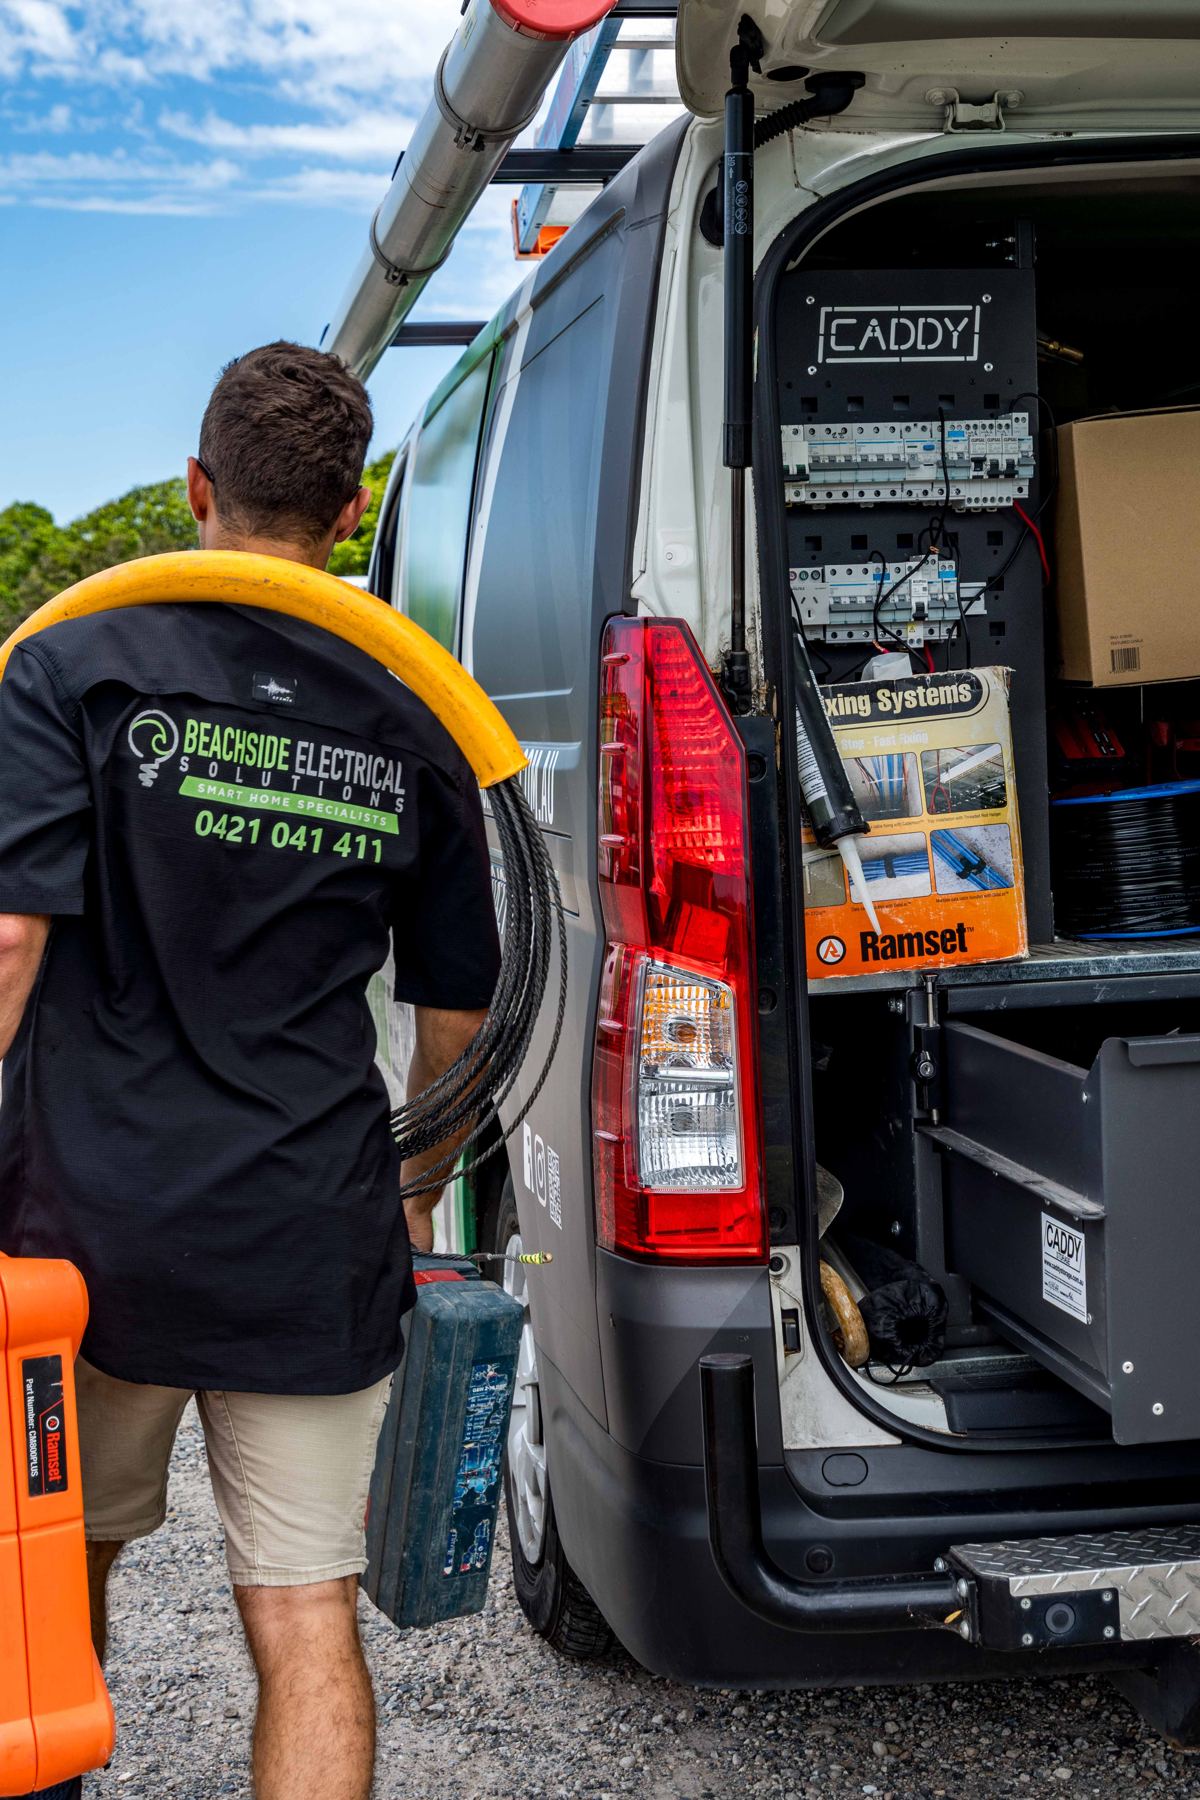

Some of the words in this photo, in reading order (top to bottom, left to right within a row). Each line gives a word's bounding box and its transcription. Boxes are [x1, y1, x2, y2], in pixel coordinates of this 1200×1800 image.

[830, 317, 969, 351] CADDY
[876, 683, 972, 715] Systems
[183, 719, 292, 771] BEACHSIDE
[295, 740, 406, 795] ELECTRICAL
[179, 755, 404, 813] SOLUTIONS
[197, 783, 243, 800] SMART
[249, 792, 290, 808] HOME
[297, 799, 388, 826] SPECIALISTS
[195, 810, 261, 844] 0421
[270, 821, 324, 854] 041
[333, 832, 382, 864] 411
[1046, 1224, 1081, 1262] CADDY
[26, 1378, 34, 1395] Part
[27, 1396, 37, 1429] Number:
[47, 1432, 62, 1482] Ramset
